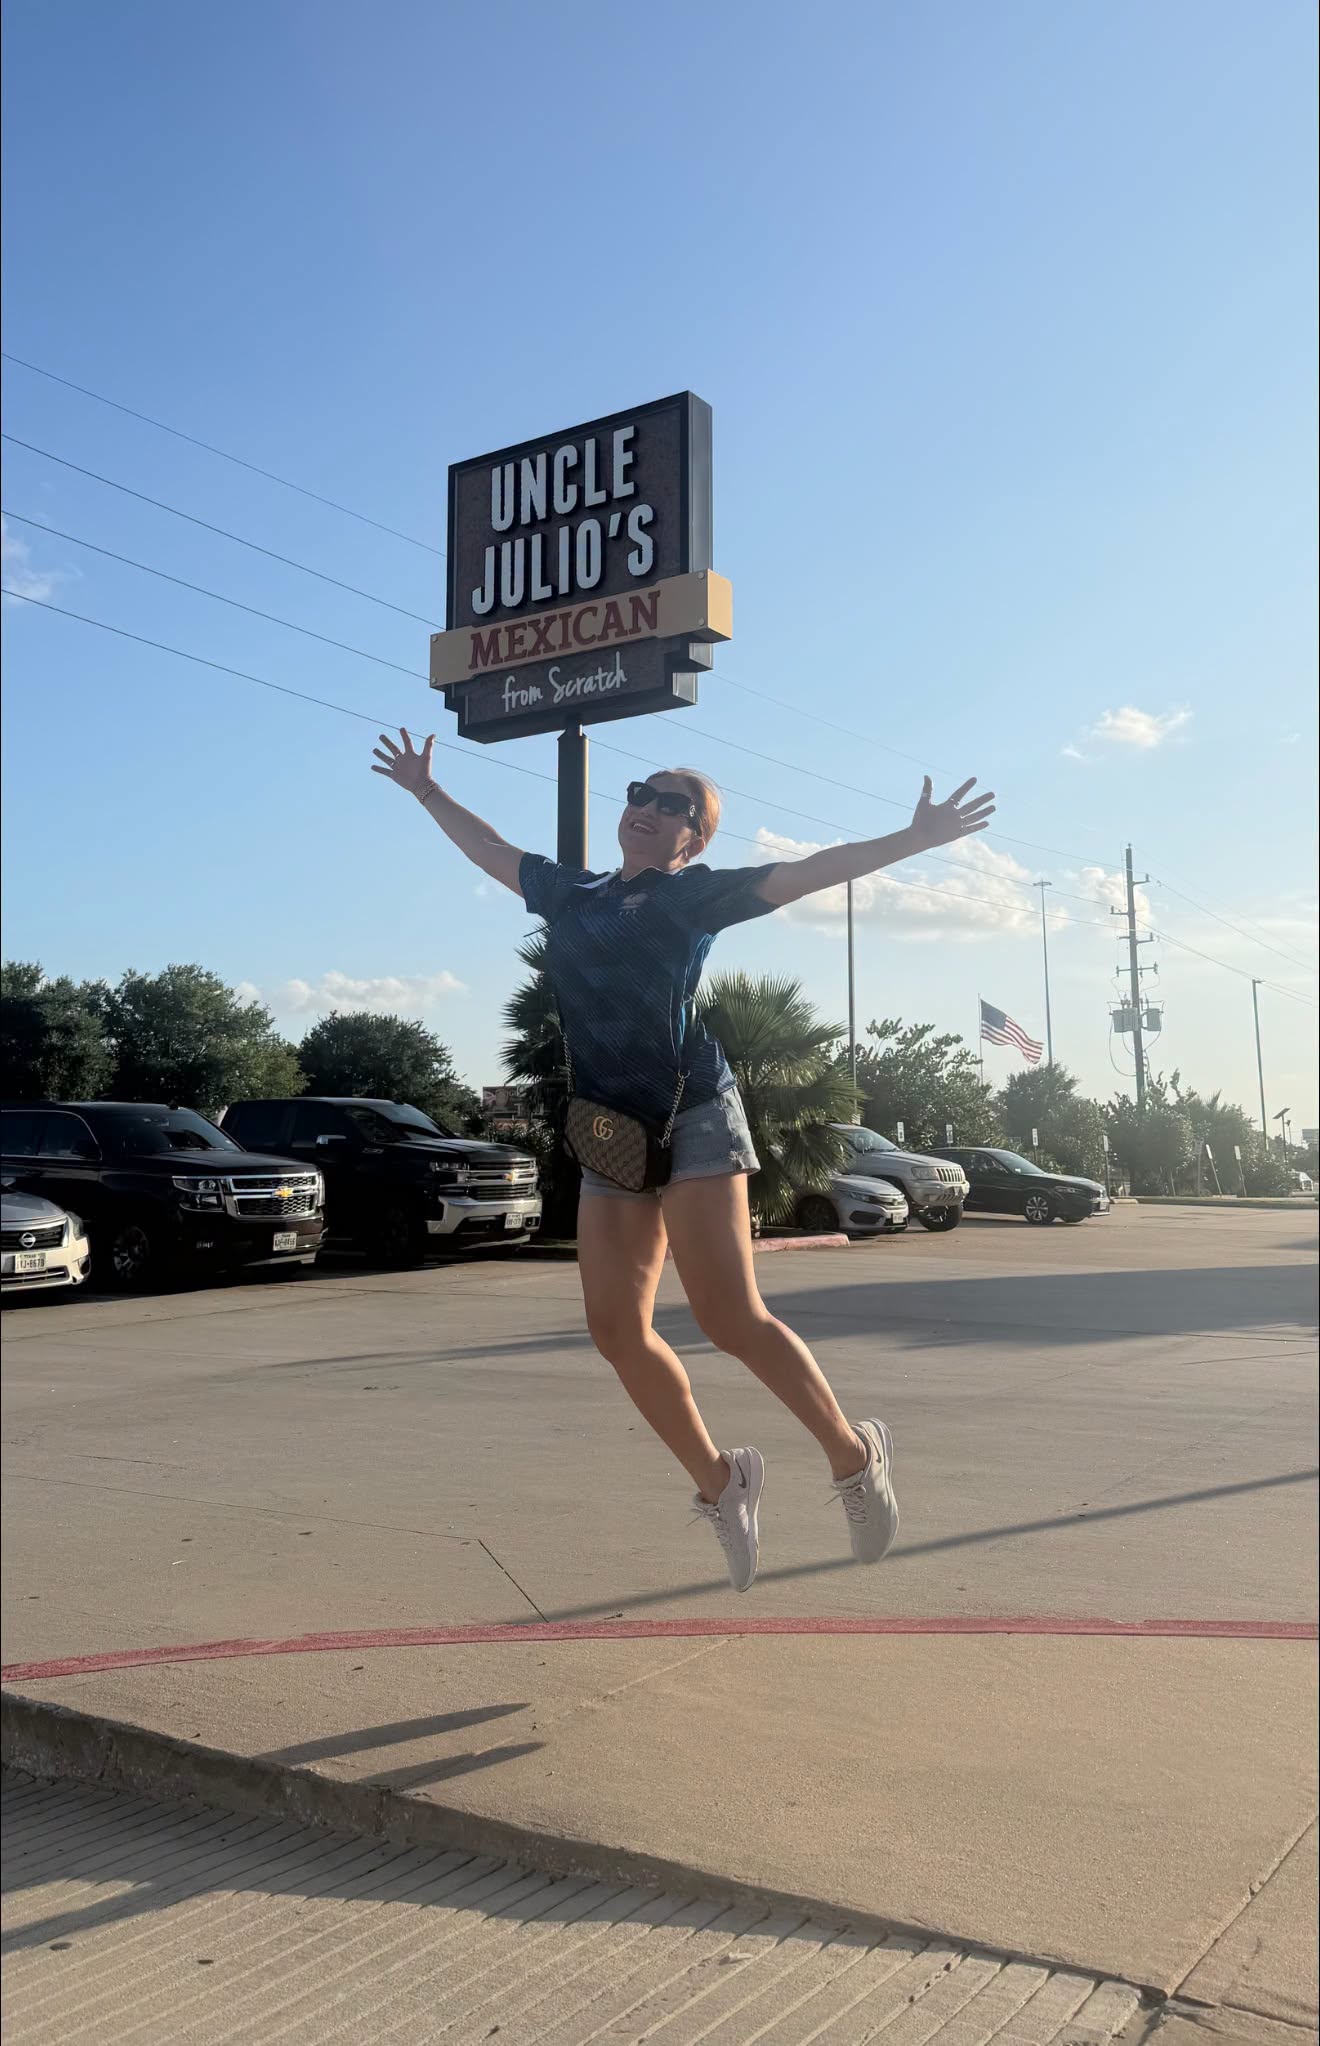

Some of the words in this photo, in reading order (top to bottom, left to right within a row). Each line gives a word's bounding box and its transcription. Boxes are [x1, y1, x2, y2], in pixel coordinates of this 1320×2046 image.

[490, 424, 635, 532] UNCLE
[471, 503, 654, 615] JULIO'S
[468, 590, 661, 670] MEXICAN
[501, 675, 543, 712] from
[548, 651, 627, 703] Scratch
